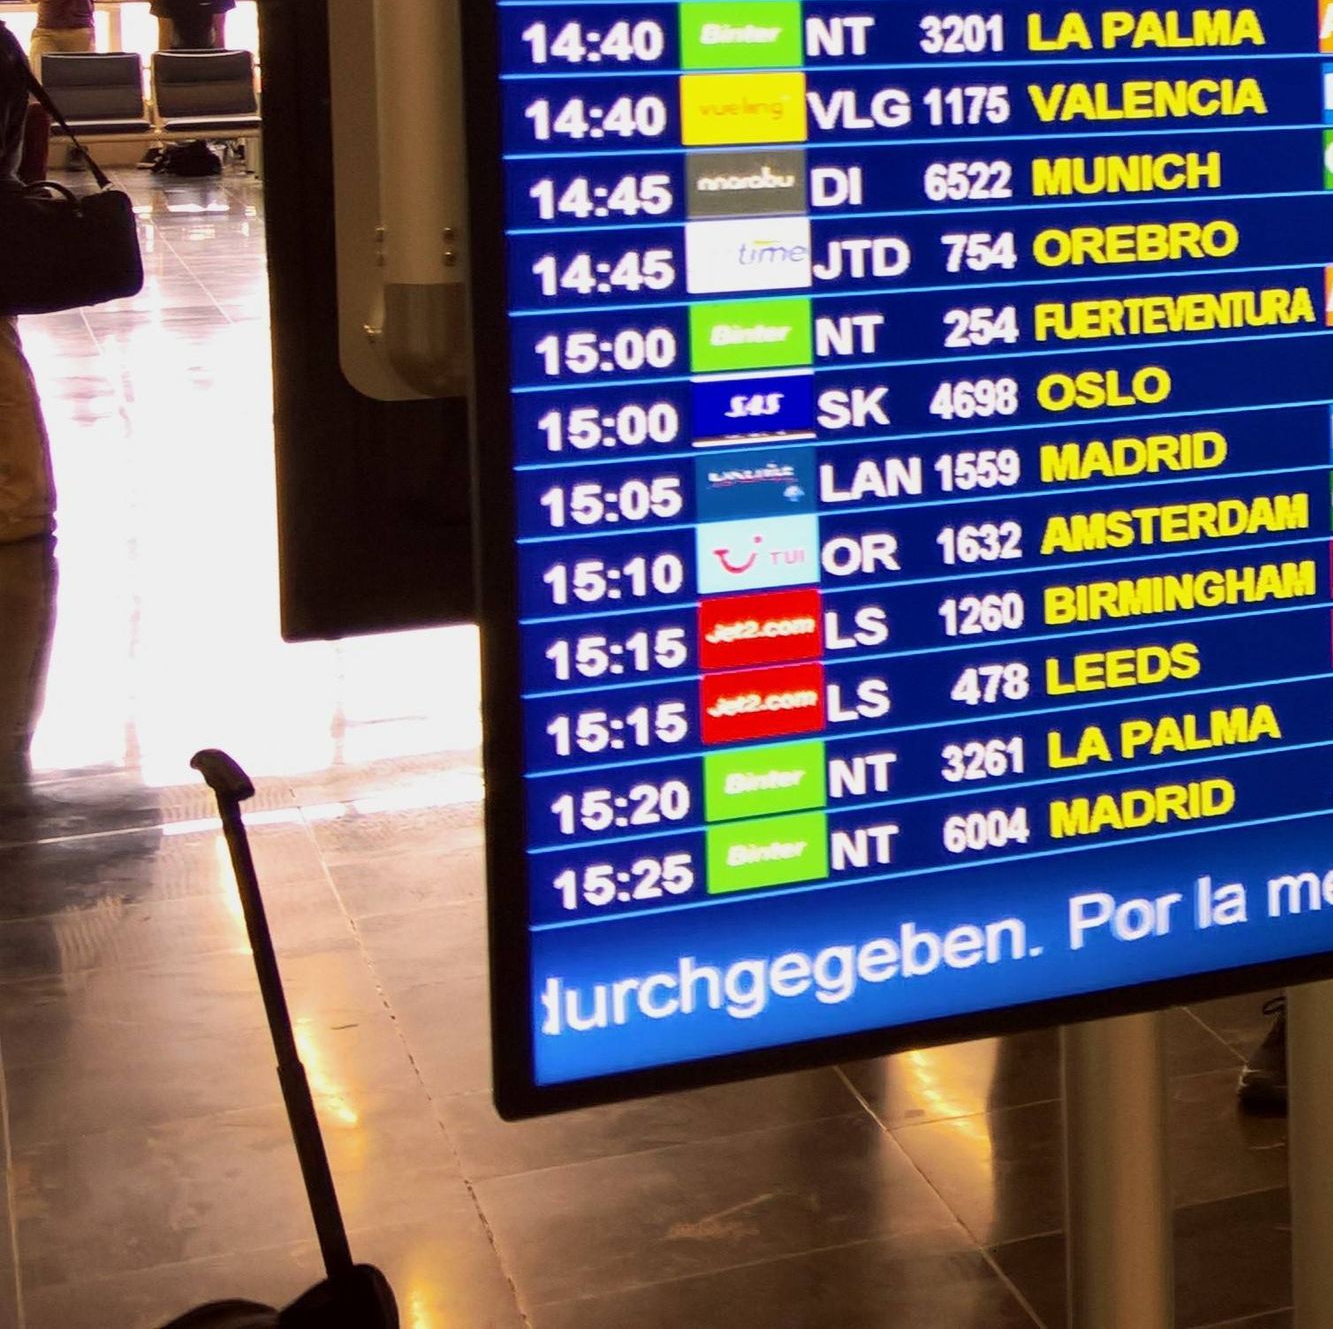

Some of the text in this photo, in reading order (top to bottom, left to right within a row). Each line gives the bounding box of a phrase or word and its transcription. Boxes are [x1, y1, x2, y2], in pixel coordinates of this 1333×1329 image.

[524, 95, 668, 141] 14:40
[806, 87, 913, 131] VLG
[923, 84, 1011, 126] 1175
[1026, 77, 1269, 123] VALENCIA
[531, 248, 676, 297] 14:45
[811, 236, 912, 281] JTD
[939, 230, 1018, 273] 754
[1032, 219, 1240, 268] OREBRO
[542, 552, 685, 606] 15:10
[820, 532, 902, 577] OR
[935, 520, 1023, 566] 1632
[1039, 492, 1310, 556] AMSTERDAM
[545, 700, 689, 757] 15:15
[825, 677, 892, 724] LS
[949, 661, 1030, 707] 478
[1044, 641, 1201, 696] LEEDS
[1068, 891, 1183, 951] Por
[1197, 875, 1248, 930] la
